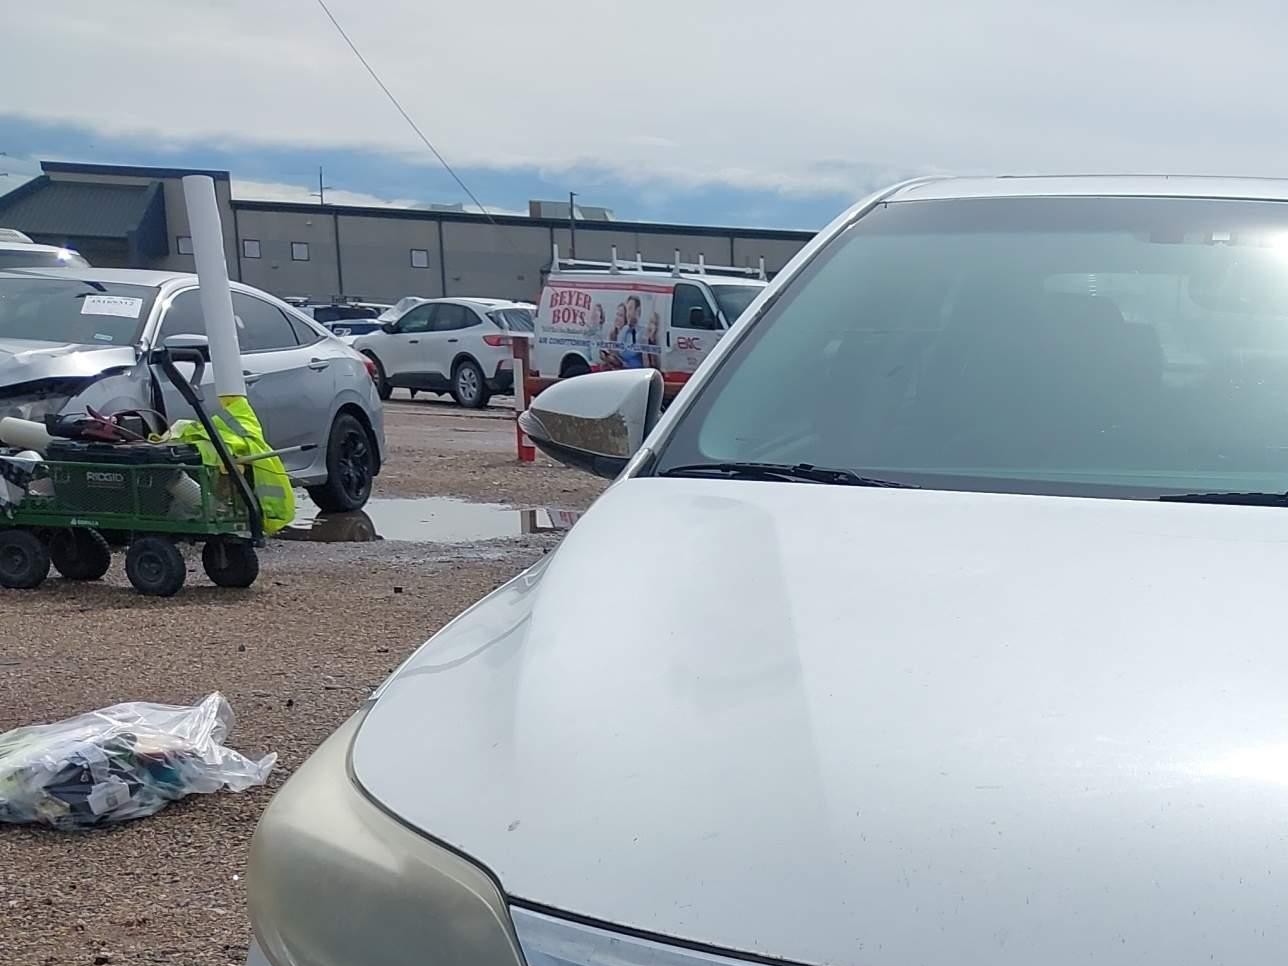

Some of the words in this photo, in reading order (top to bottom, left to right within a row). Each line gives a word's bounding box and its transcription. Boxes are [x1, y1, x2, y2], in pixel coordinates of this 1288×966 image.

[550, 290, 592, 311] BEYER
[552, 308, 586, 326] BOYS
[86, 471, 124, 482] RIDGID
